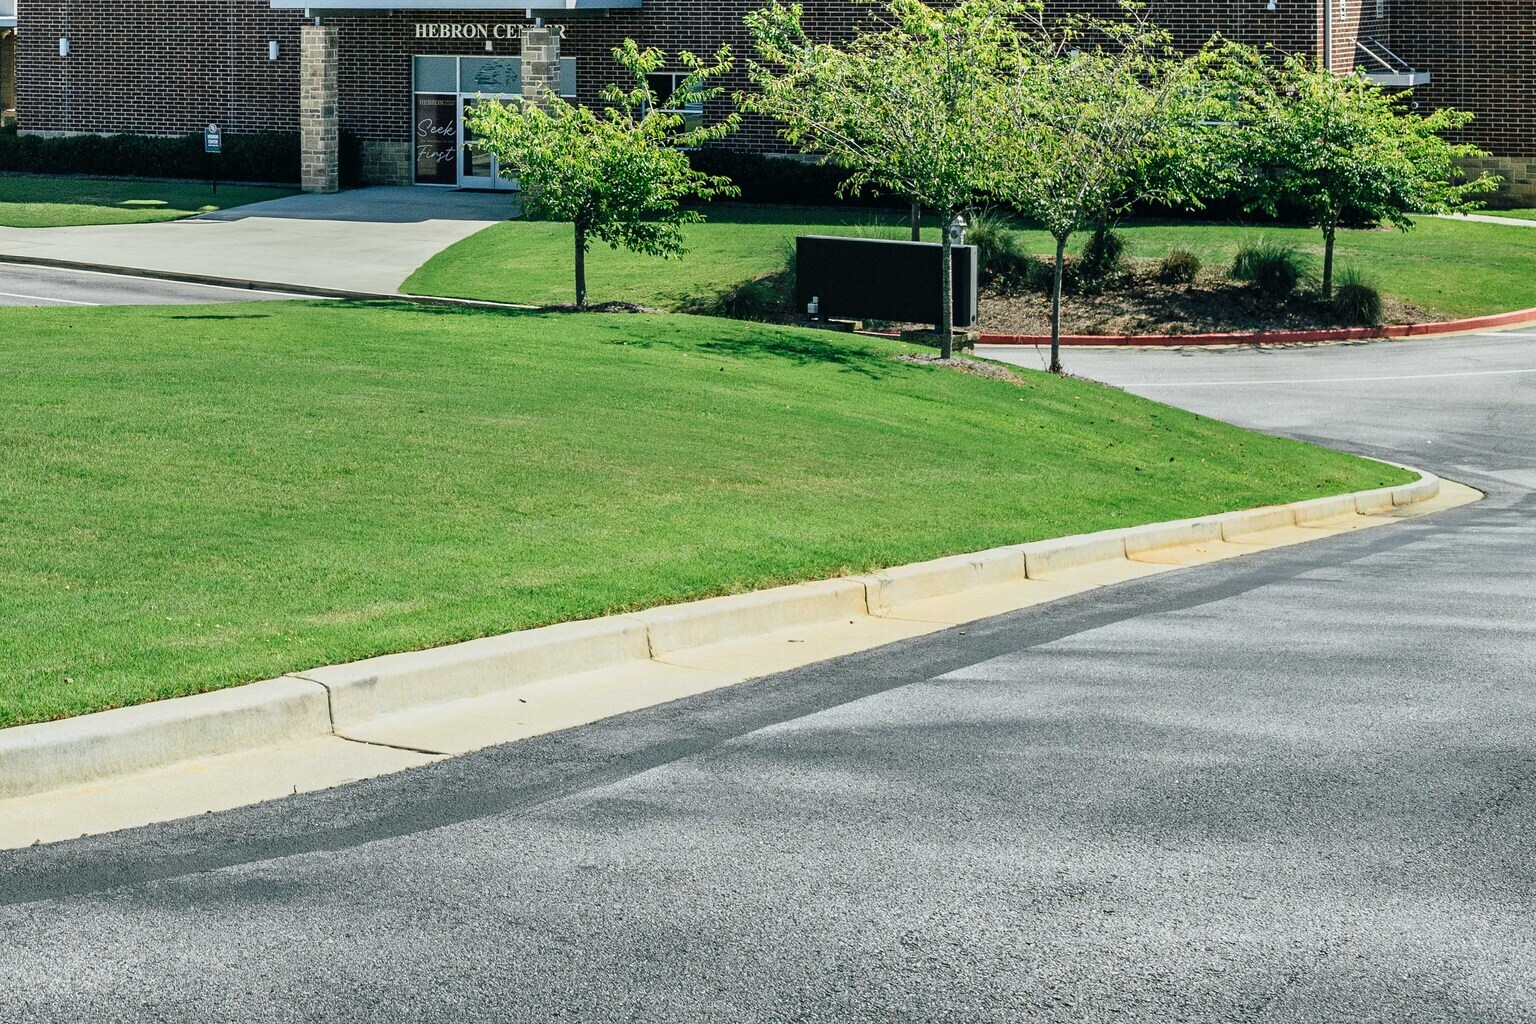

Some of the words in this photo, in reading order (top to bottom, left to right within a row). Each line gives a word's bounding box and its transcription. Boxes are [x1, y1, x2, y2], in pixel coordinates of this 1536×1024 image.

[415, 23, 488, 38] HEBRON
[493, 23, 567, 39] CENR
[417, 118, 456, 137] Seek
[417, 144, 456, 163] First
